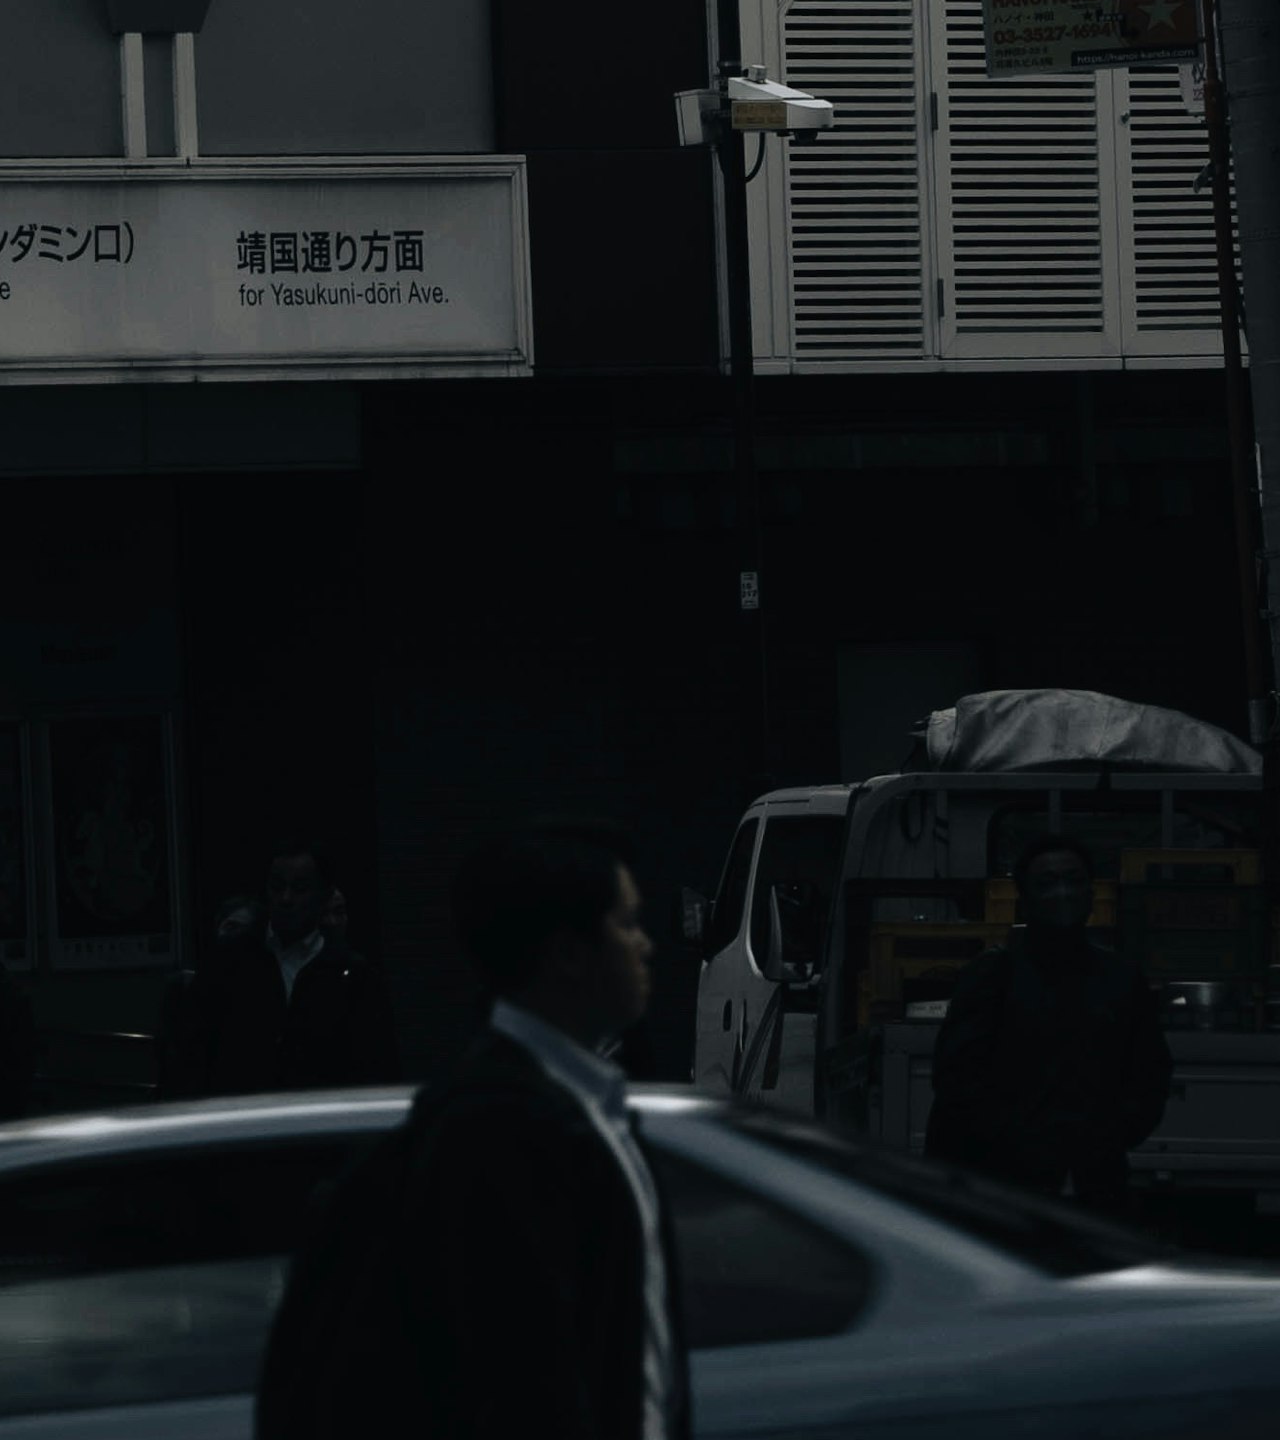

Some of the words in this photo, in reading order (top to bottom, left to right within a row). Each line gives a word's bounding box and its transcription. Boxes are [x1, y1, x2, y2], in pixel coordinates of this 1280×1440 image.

[236, 229, 425, 275] 靖国通り方面
[238, 283, 265, 307] for
[271, 280, 404, 308] Yasukuni-dōri
[409, 281, 450, 306] Ave.
